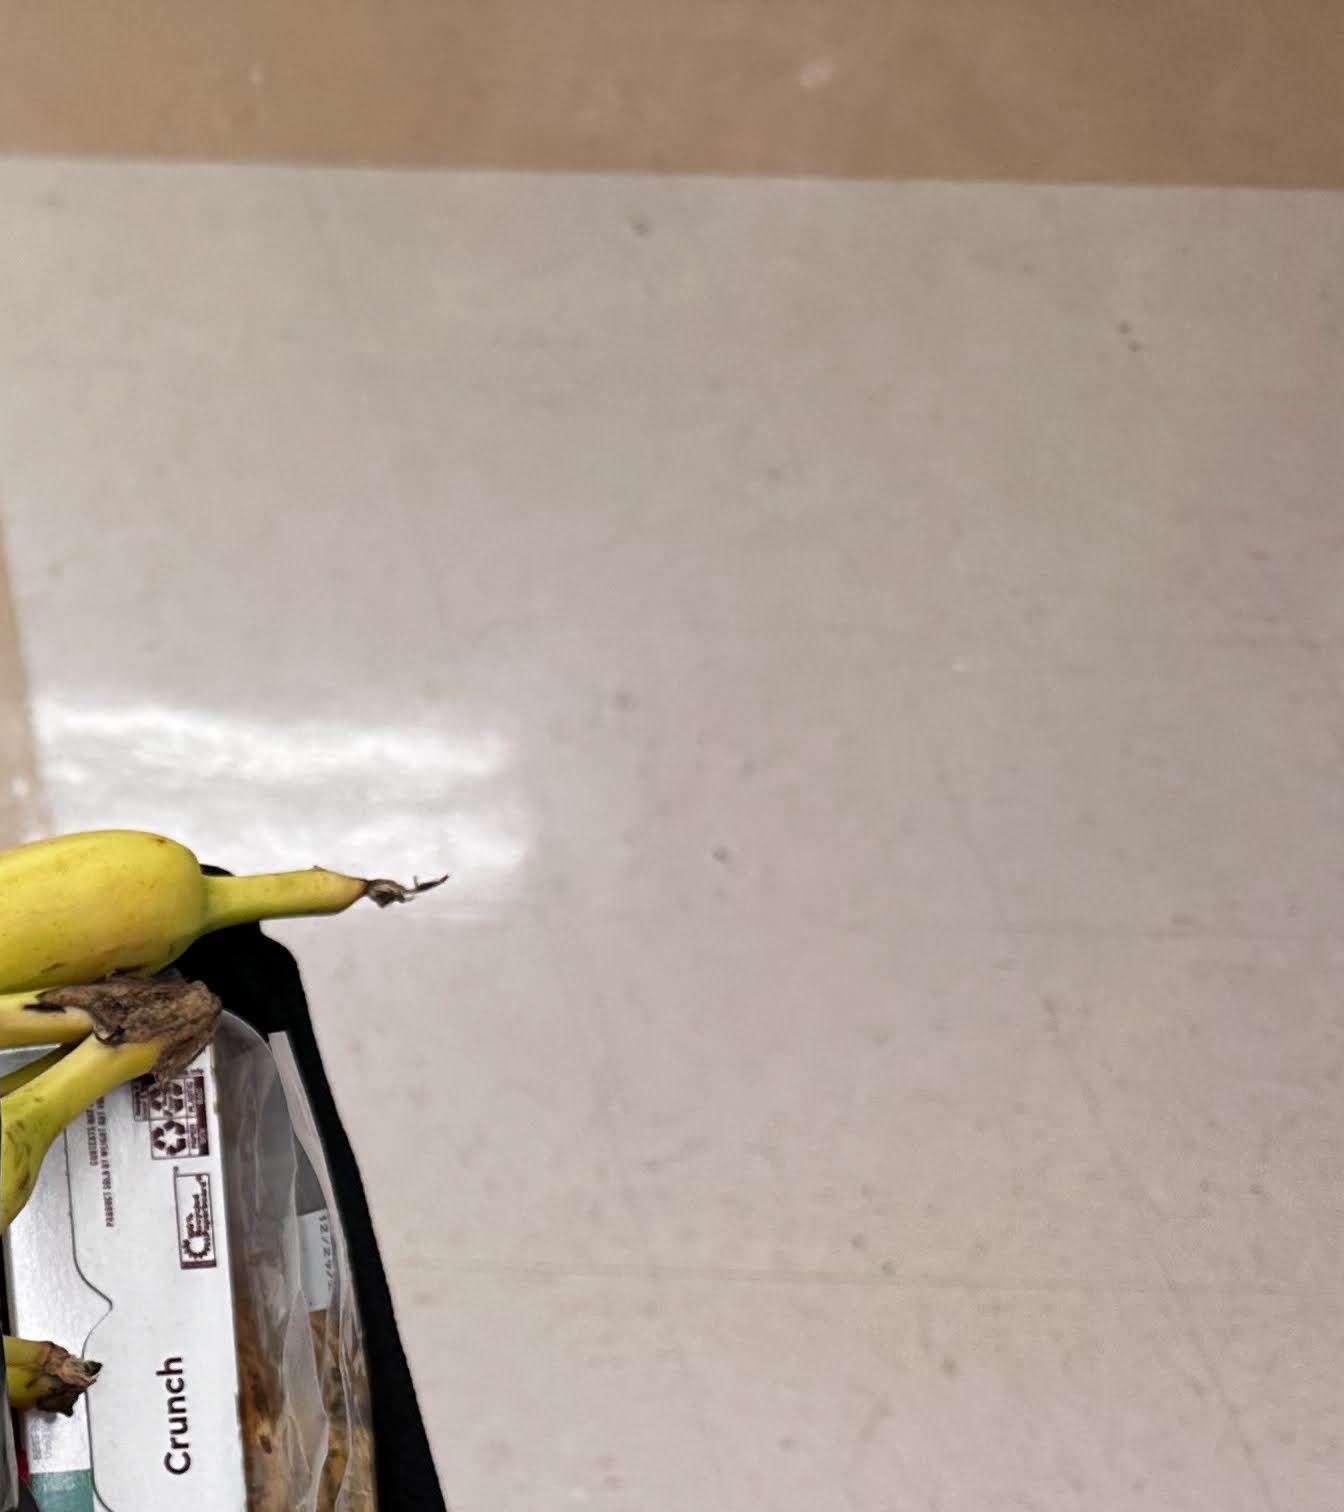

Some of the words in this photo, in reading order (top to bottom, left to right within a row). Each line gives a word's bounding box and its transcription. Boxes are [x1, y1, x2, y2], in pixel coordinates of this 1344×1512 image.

[87, 1127, 100, 1167] CONTENTS
[97, 1127, 109, 1158] WEIGHT
[102, 1170, 113, 1191] SOLD
[103, 1192, 116, 1228] PRODUCT
[154, 1355, 194, 1477] Crunch
